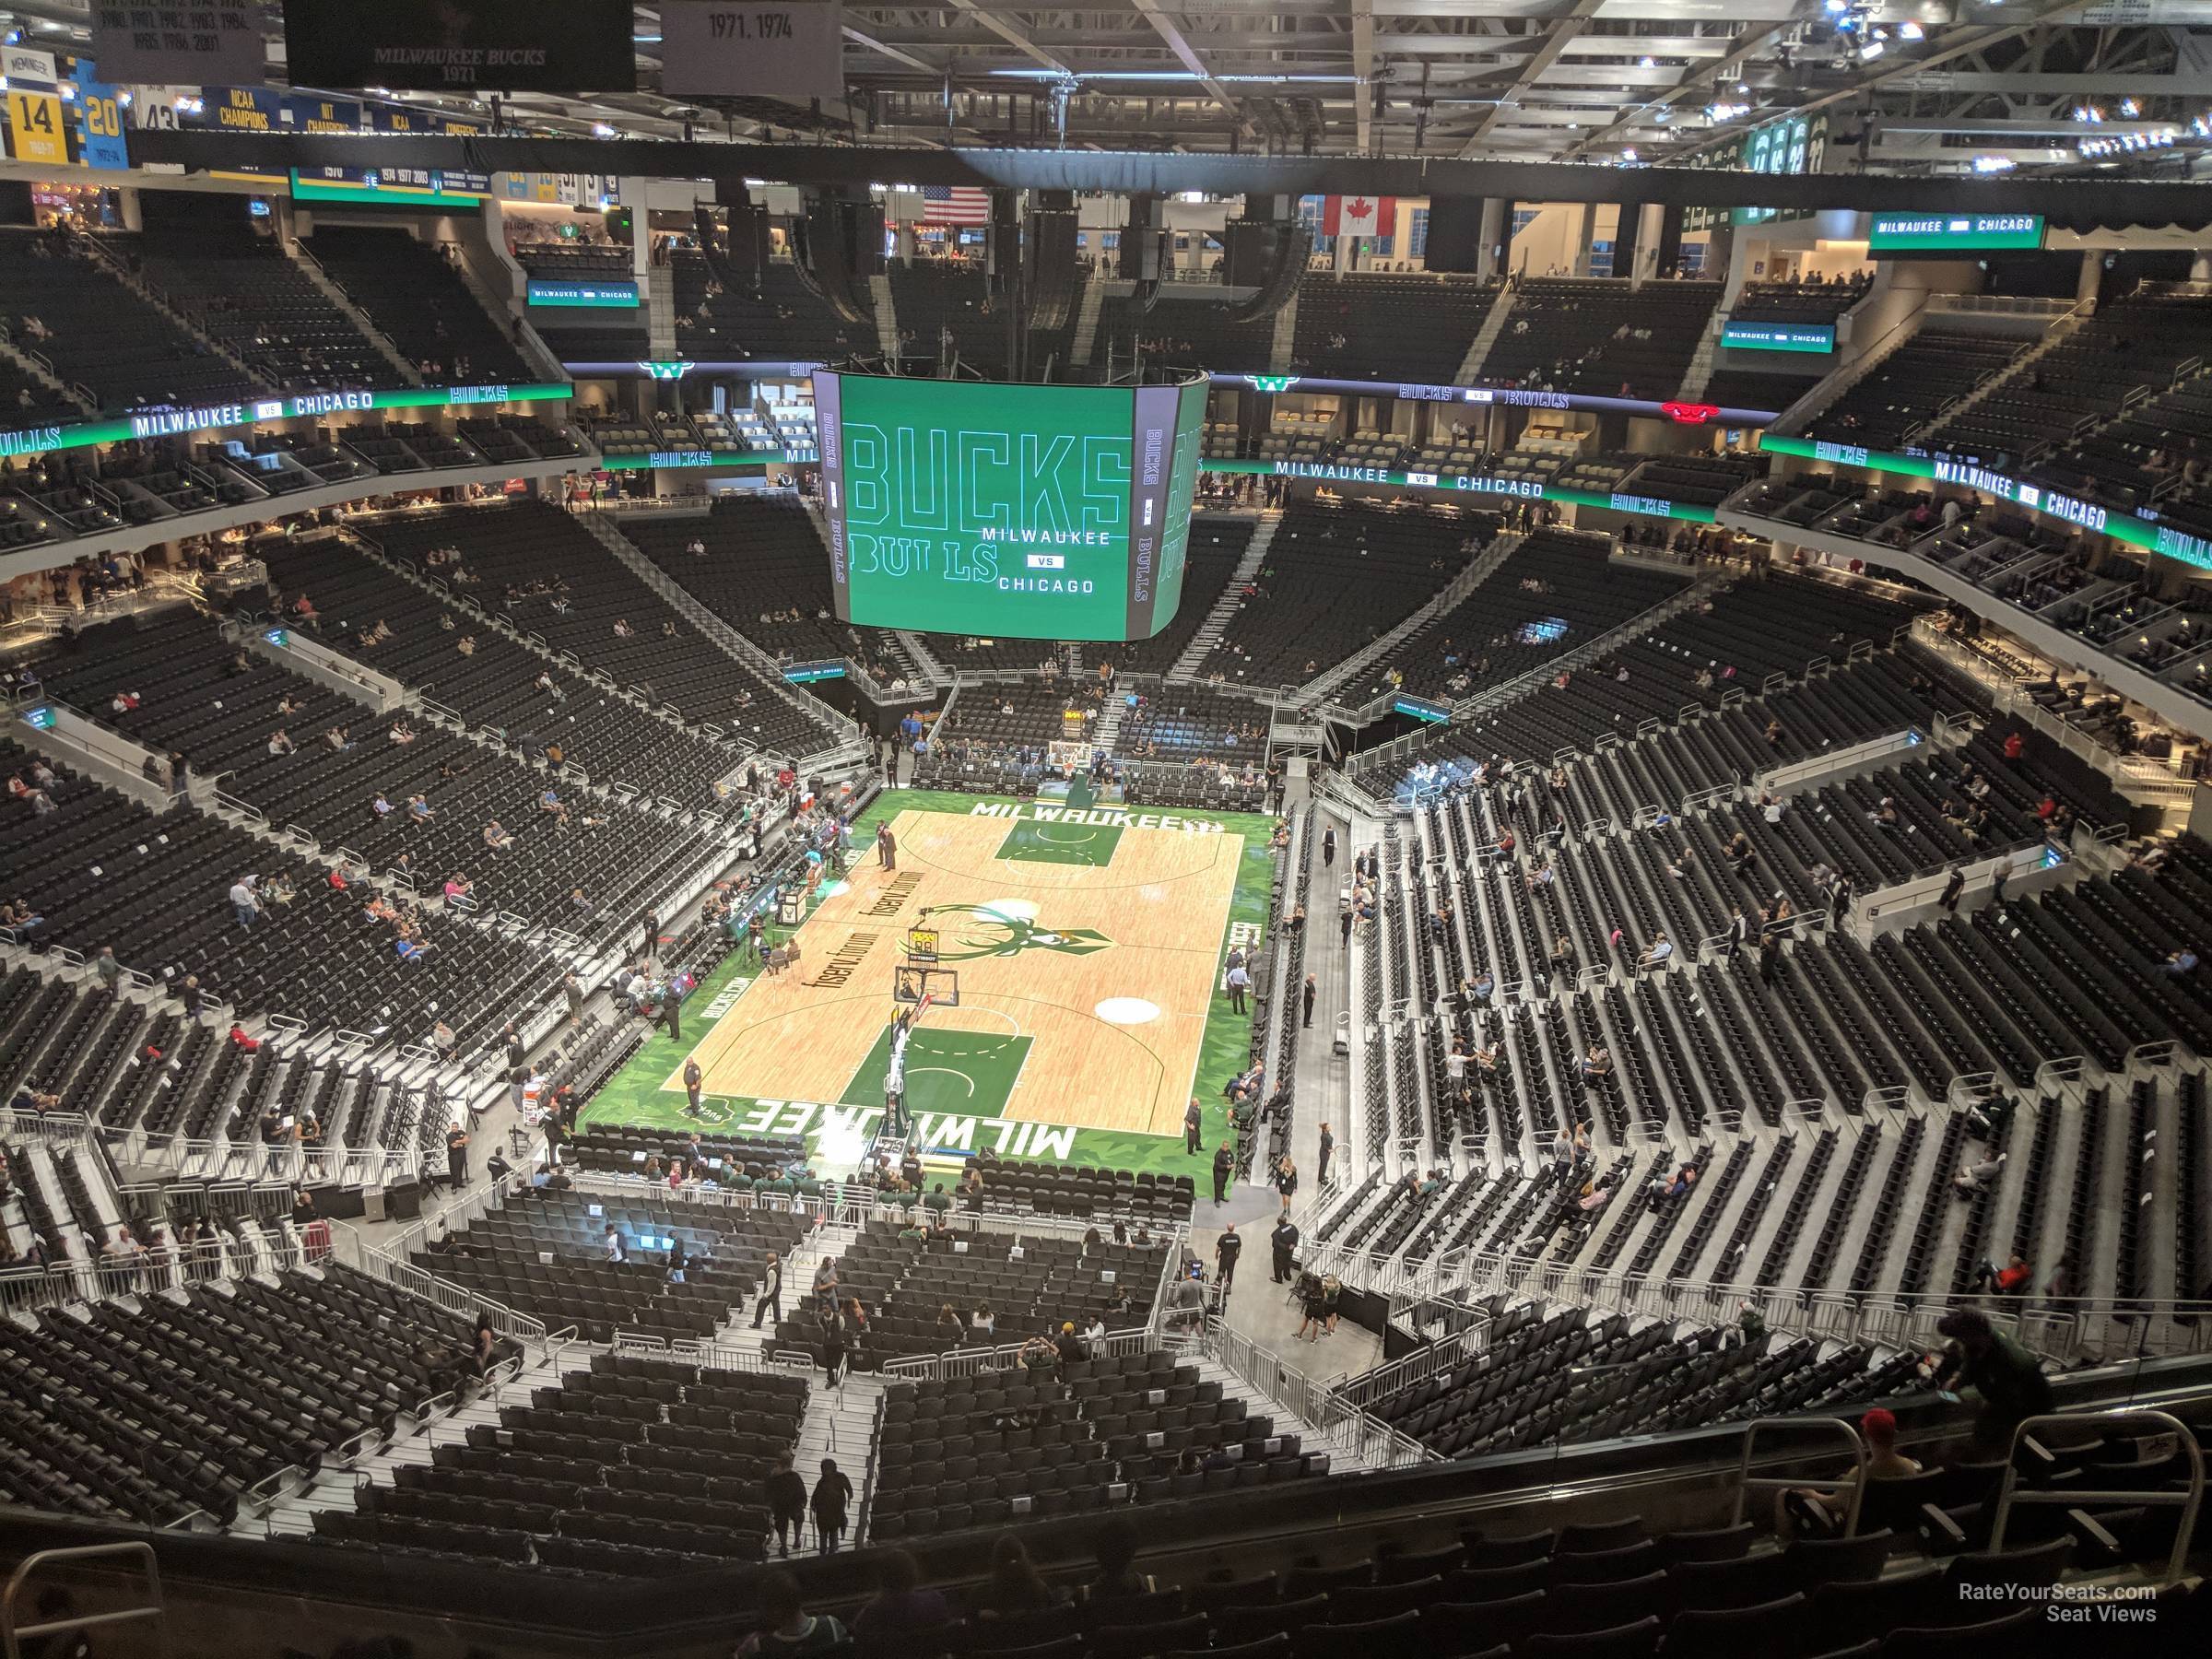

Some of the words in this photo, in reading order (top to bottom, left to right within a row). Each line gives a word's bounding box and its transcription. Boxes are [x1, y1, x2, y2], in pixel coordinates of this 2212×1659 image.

[757, 14, 793, 40] 1974
[374, 47, 483, 65] MILWAUKEE
[488, 49, 547, 66] BUCKS
[441, 65, 476, 82] 1971
[230, 89, 255, 110] NCAA
[321, 102, 334, 120] NIT
[19, 96, 54, 135] 14
[86, 97, 120, 137] 20
[219, 107, 269, 131] CHAMPIONS
[392, 113, 410, 131] NCAA
[1877, 220, 1943, 233] MILWAUKEE
[1978, 218, 2033, 231] CHICAGO
[1728, 331, 1771, 340] MILWAUKEE
[1793, 335, 1827, 343] CHICAGO
[450, 385, 508, 404] BUCKS
[1399, 382, 1453, 401] BUCKS
[1505, 389, 1570, 409] BULLS
[136, 406, 243, 437] MILWAUKEE
[265, 406, 276, 415] VS
[297, 393, 373, 415] CHICAGO
[0, 427, 61, 454] ULLS
[823, 412, 838, 469] BUCKS
[650, 451, 712, 468] BUCKS
[1143, 429, 1163, 486] BUCKS
[1816, 441, 1867, 466] BUCKS
[842, 422, 1133, 538] BUCKS
[1275, 461, 1388, 483] MILWAUKEE
[1416, 475, 1429, 484] VS
[1456, 476, 1543, 498] CHICAGO
[1610, 493, 1671, 517] BUCKS
[1936, 462, 2013, 497] MILWAUKEE
[2046, 492, 2108, 531] CHICAGO
[982, 527, 1111, 546] MILWAUKEE
[1038, 557, 1053, 566] VS
[1135, 537, 1153, 602] BULLS
[999, 576, 1093, 594] CHICAGO
[970, 802, 1182, 830] MILWAUKEE
[858, 871, 925, 917] fiserv.forum
[801, 933, 880, 989] fiserv.forum
